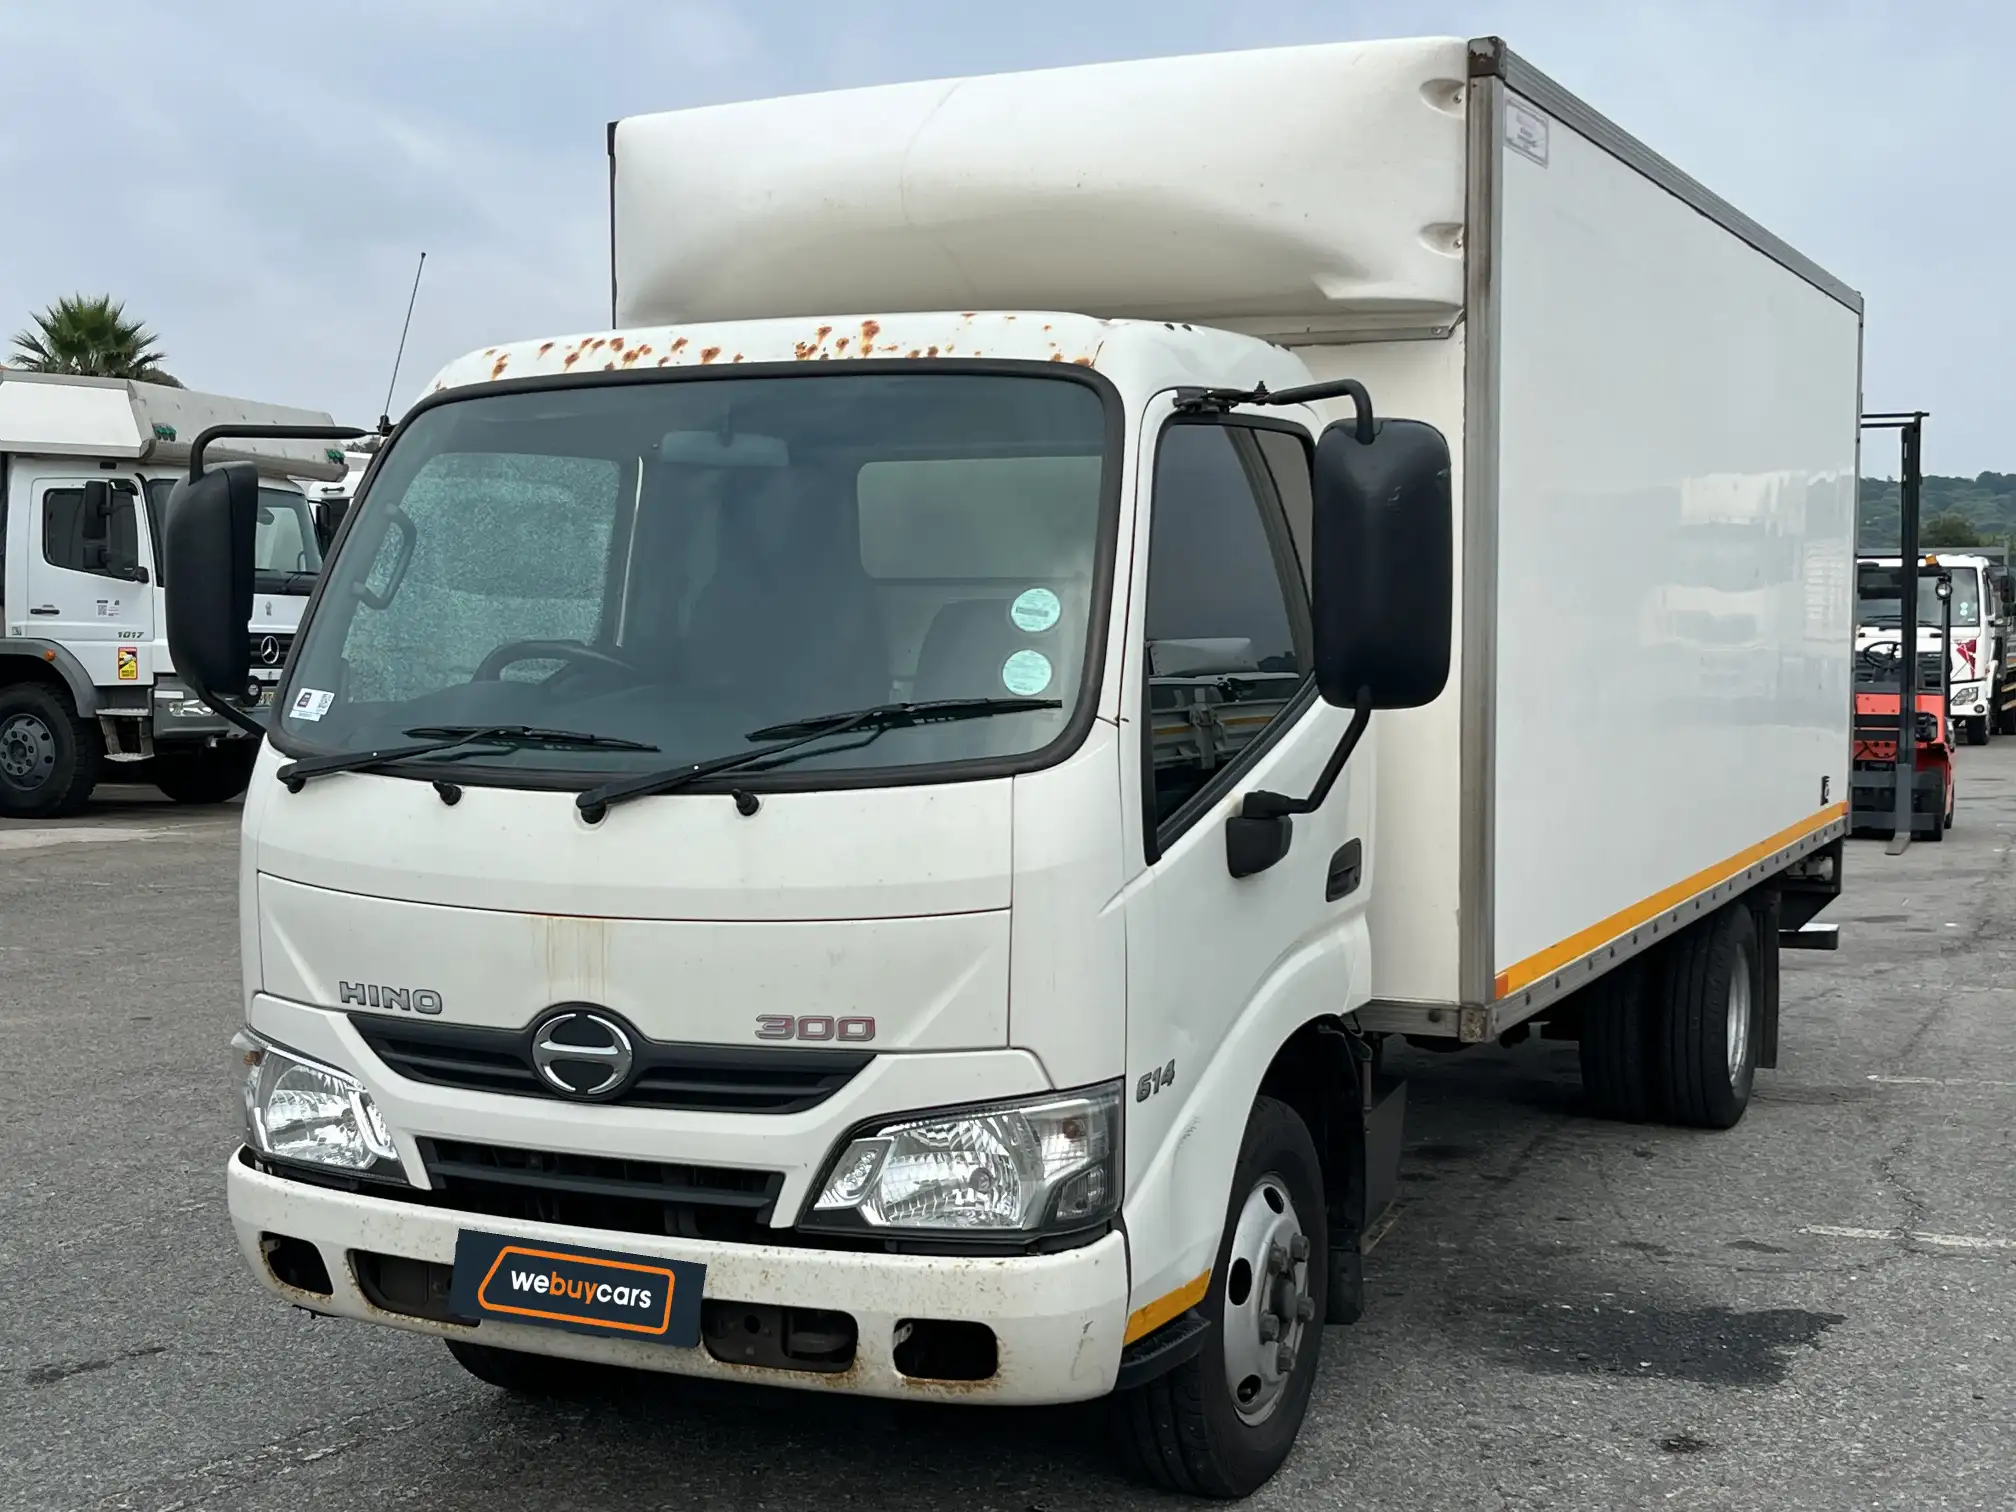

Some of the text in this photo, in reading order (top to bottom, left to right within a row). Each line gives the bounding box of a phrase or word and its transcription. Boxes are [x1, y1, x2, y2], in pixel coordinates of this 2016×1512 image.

[339, 980, 443, 1015] HINO
[754, 1014, 876, 1042] 300
[1136, 1058, 1175, 1103] 614
